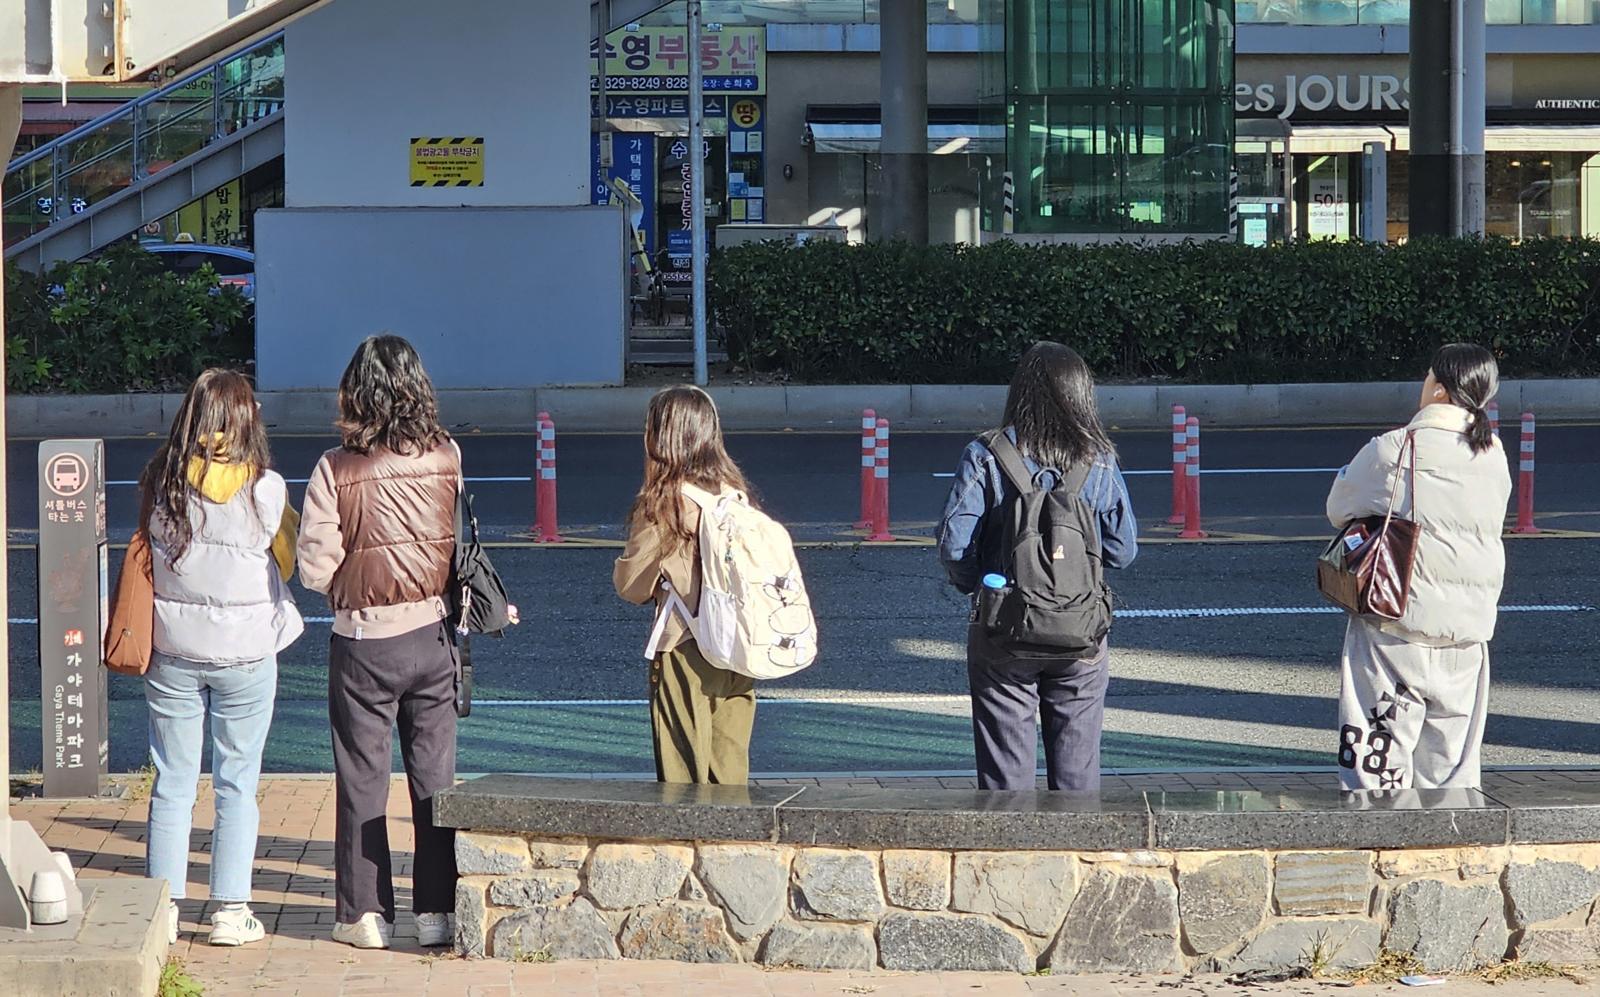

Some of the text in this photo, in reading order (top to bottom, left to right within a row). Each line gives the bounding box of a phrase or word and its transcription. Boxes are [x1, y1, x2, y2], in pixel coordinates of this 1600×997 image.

[736, 103, 757, 125] 땅
[452, 147, 480, 157] 부착금지
[48, 511, 85, 523] 타는 곳
[54, 684, 65, 769] Gaya Theme Park
[66, 652, 84, 768] 가야테마파크
[1338, 723, 1393, 775] 88
